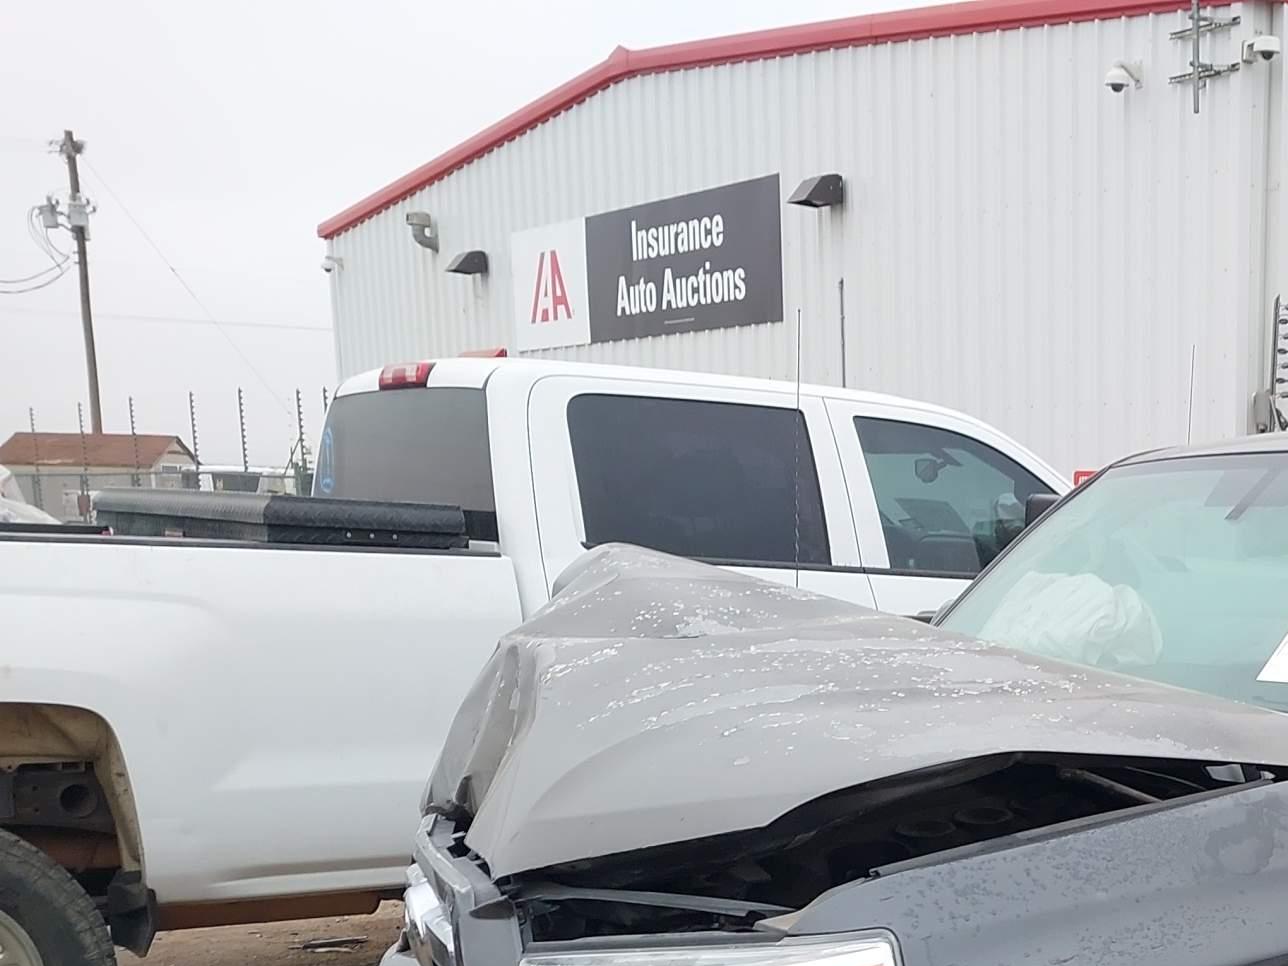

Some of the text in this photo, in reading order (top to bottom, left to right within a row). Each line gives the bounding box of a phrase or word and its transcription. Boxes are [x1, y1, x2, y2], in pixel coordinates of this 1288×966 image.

[631, 213, 724, 261] Insurance
[616, 261, 746, 317] Auto Auctions
